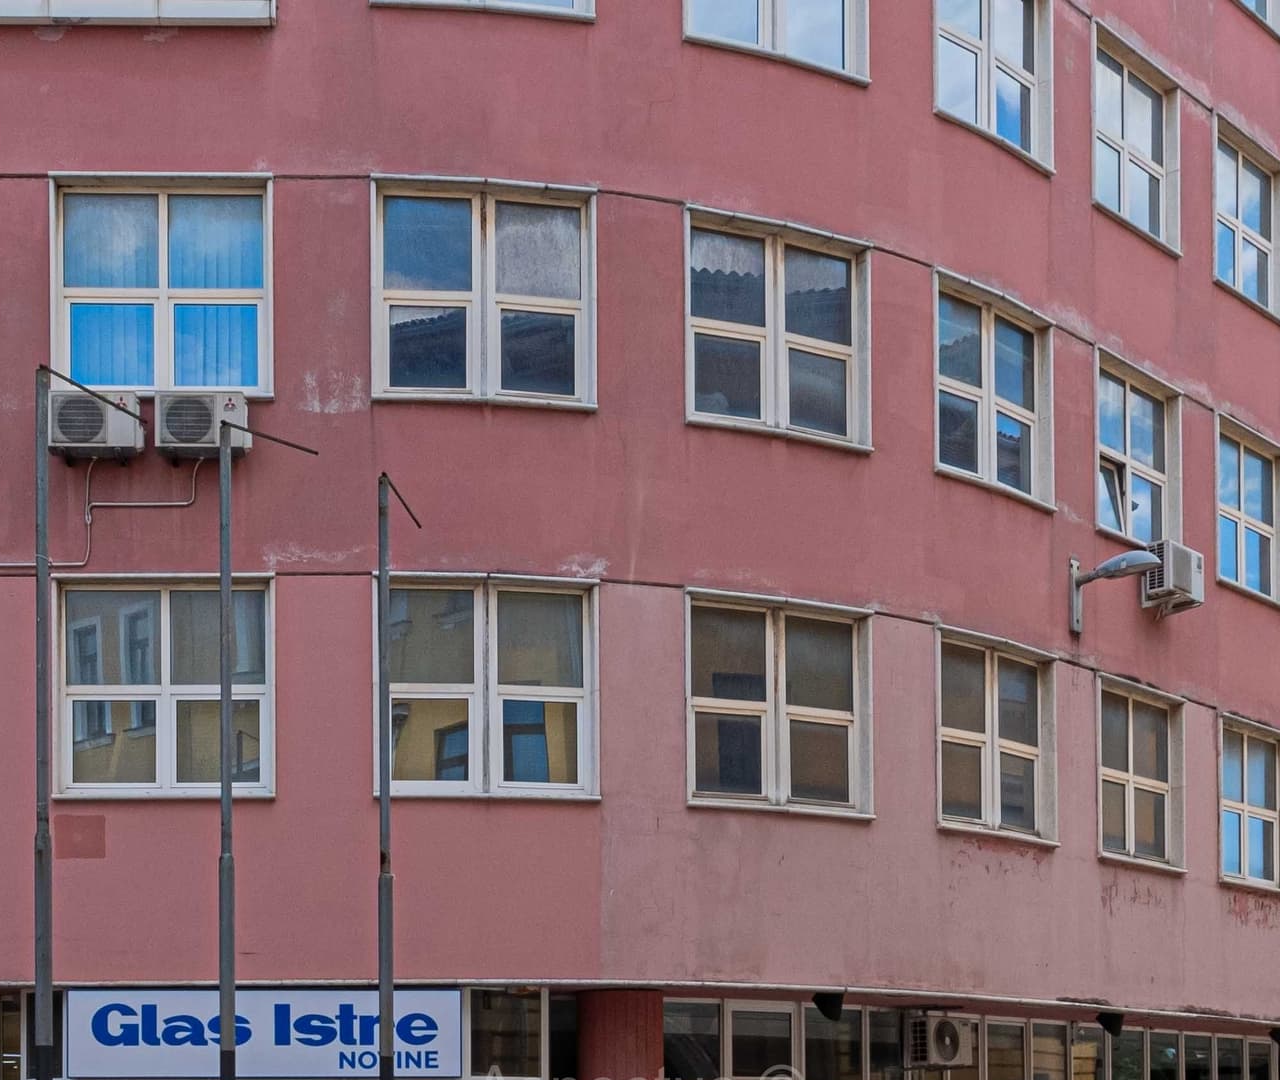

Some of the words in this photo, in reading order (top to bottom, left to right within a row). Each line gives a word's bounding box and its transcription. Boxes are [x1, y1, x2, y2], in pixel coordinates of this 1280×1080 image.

[91, 1003, 252, 1047] Glas
[274, 1003, 439, 1047] Istre
[338, 1051, 439, 1069] NOINE
